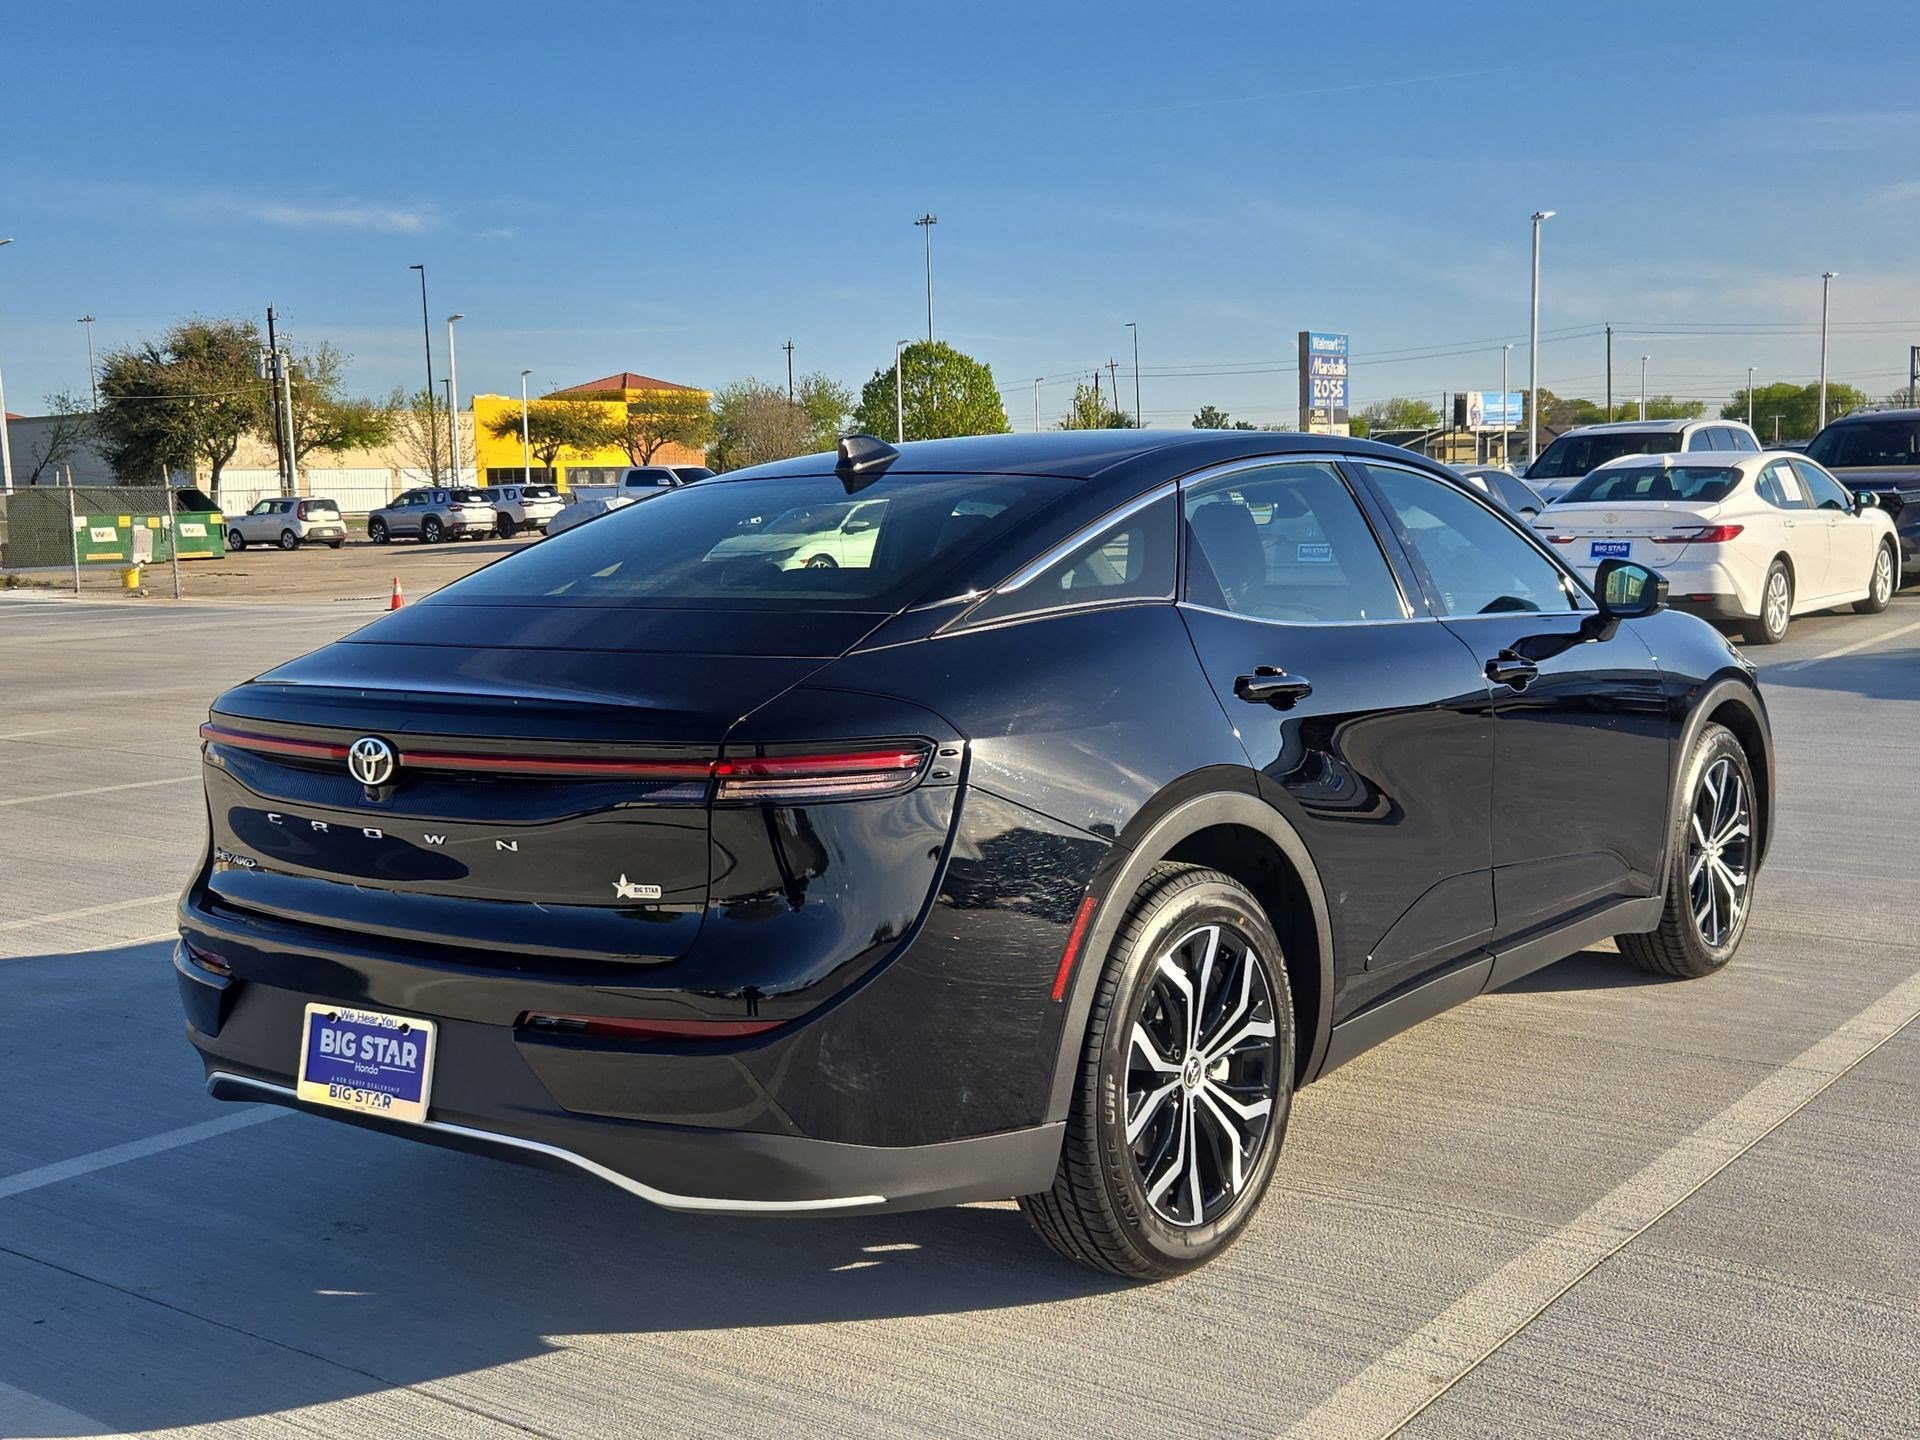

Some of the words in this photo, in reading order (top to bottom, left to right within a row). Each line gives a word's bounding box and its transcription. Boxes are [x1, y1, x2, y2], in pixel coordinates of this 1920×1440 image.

[1313, 336, 1338, 351] Walmart
[1312, 357, 1347, 375] Marshalls
[1314, 380, 1344, 398] ROSS
[267, 812, 519, 853] CROWN
[340, 1009, 354, 1021] We
[357, 1012, 378, 1024] Hear
[381, 1015, 397, 1028] You
[320, 1028, 357, 1057] BIG
[360, 1035, 418, 1068] STAR
[354, 1063, 379, 1075] Honda
[367, 1081, 400, 1093] DEALERSHIP
[329, 1085, 351, 1101] BIG
[355, 1090, 392, 1109] STAR
[1105, 1073, 1116, 1125] UHP
